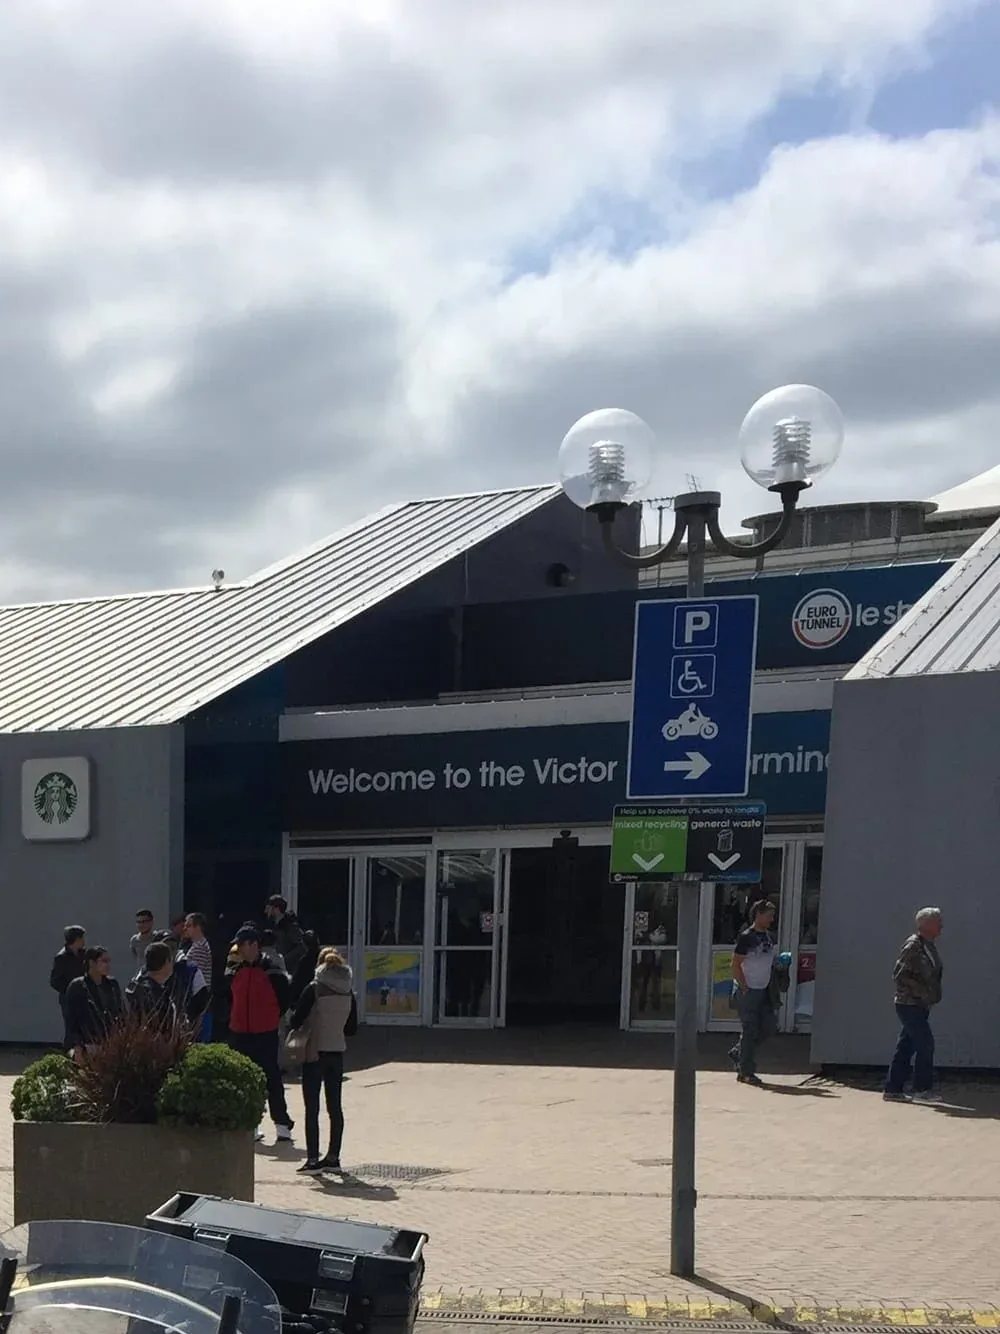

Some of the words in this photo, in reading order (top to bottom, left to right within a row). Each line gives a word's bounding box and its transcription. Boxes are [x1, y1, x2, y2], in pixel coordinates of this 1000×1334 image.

[806, 605, 838, 619] EURO
[855, 603, 879, 627] le
[684, 610, 711, 644] P
[799, 616, 843, 631] TUNNEL
[307, 767, 436, 795] Welcome
[443, 762, 471, 790] to
[478, 760, 526, 788] the
[532, 756, 619, 785] Victor
[750, 745, 831, 776] rmin
[615, 819, 644, 829] mixed
[644, 819, 687, 830] recycling
[690, 819, 730, 830] general
[732, 819, 762, 828] waste
